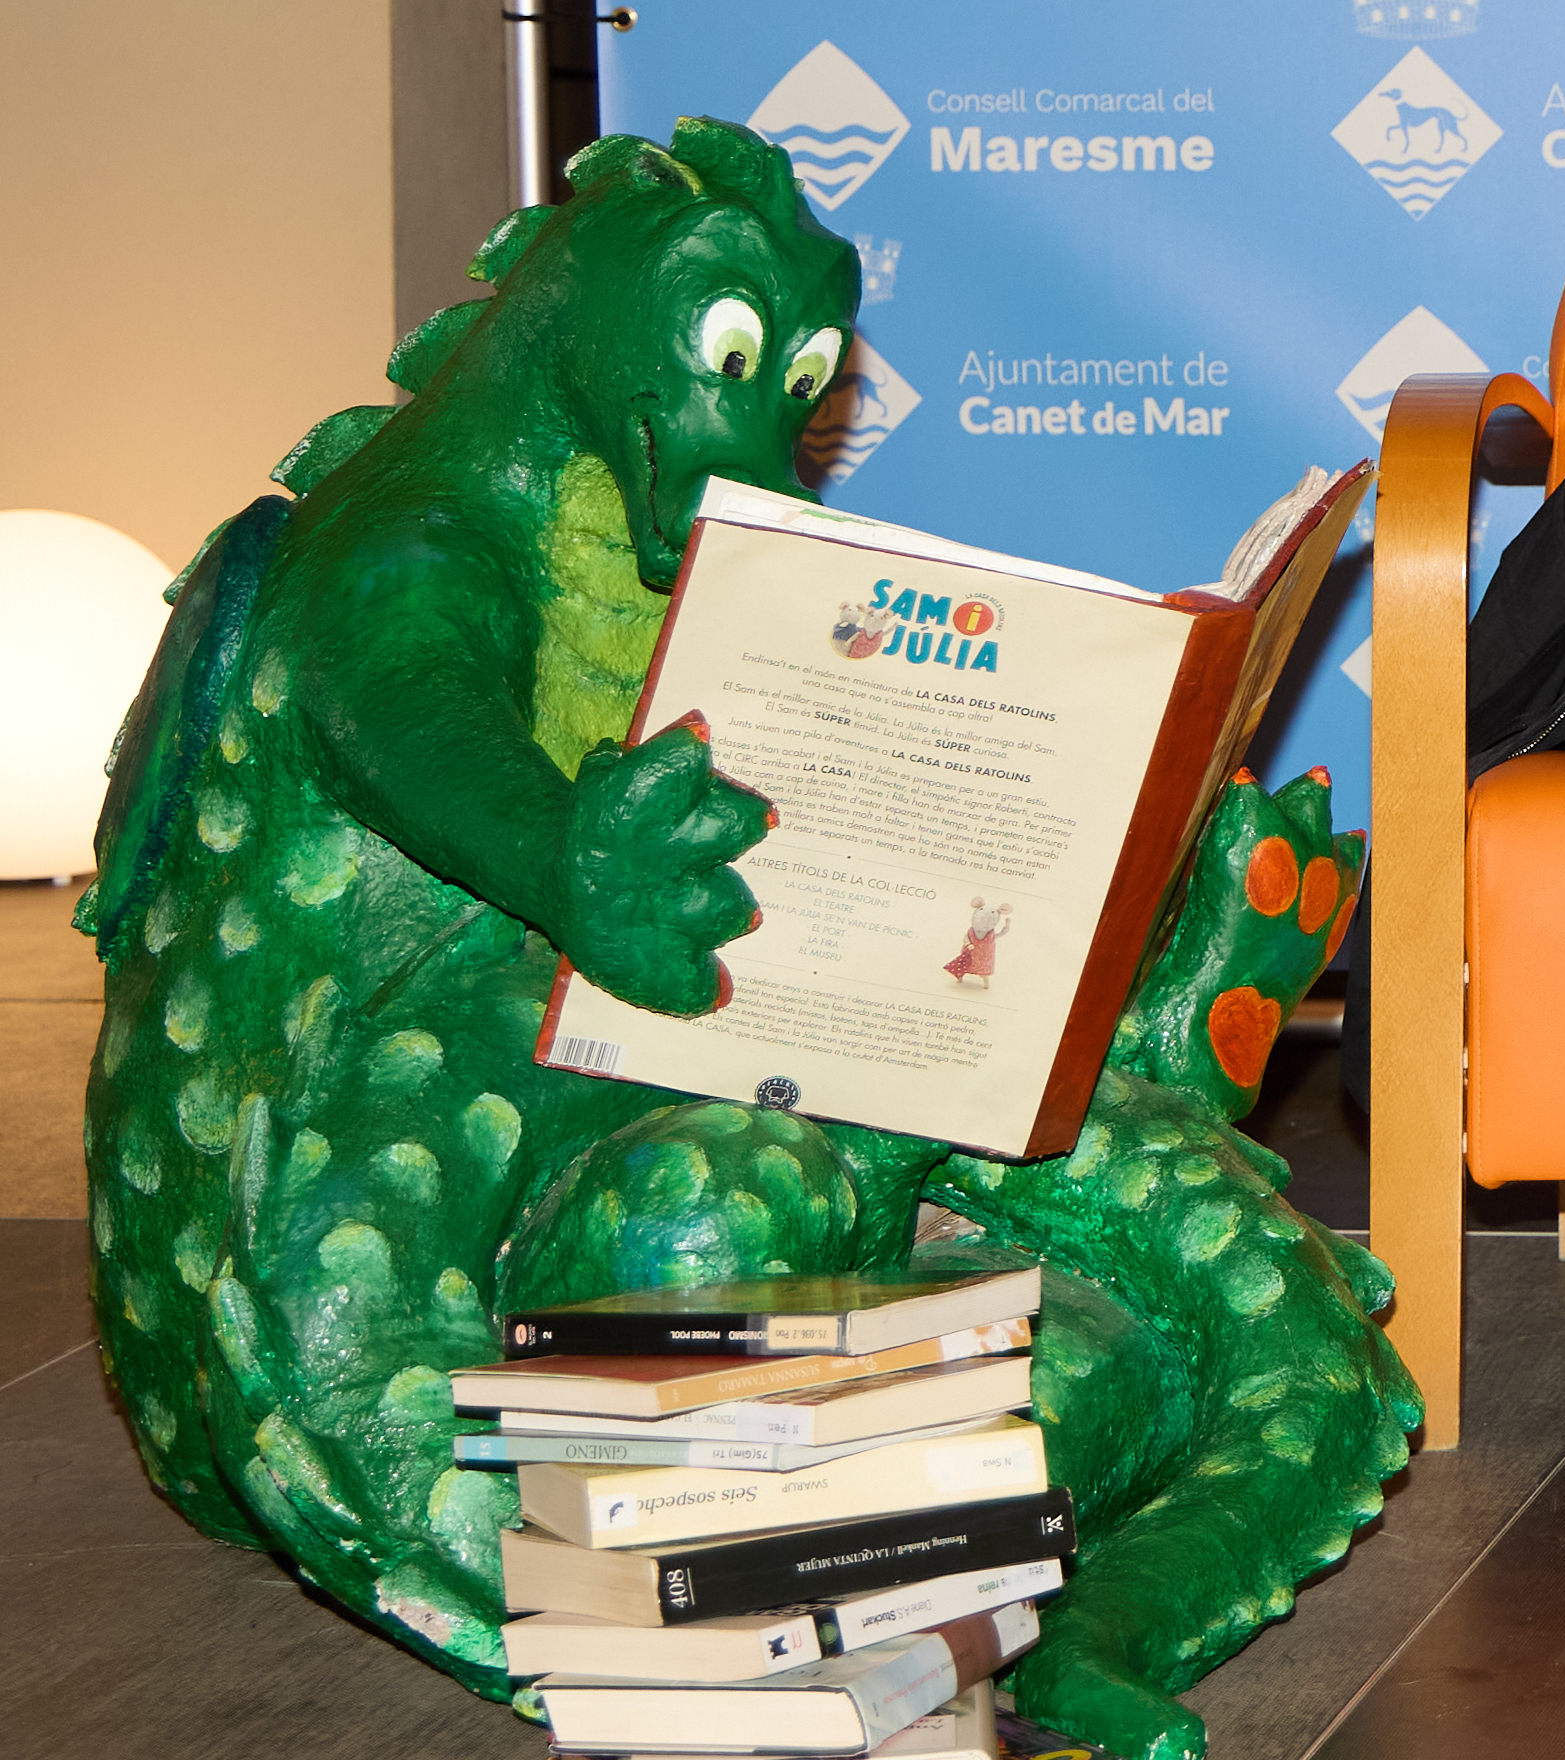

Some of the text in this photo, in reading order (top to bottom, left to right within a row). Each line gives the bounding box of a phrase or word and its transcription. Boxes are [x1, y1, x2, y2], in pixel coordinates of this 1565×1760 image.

[928, 87, 1214, 112] Consell Comarcal del
[930, 125, 1215, 173] Maresme
[958, 350, 1228, 393] Ajuntament de
[958, 395, 1230, 436] Canet de Mar
[868, 578, 952, 626] SAM
[881, 624, 999, 673] JÚLIA
[852, 677, 898, 695] miniatura
[901, 686, 913, 697] de
[916, 689, 930, 700] LA
[934, 692, 965, 706] CASA
[968, 698, 996, 710] DELS
[814, 711, 852, 727] SÚPER
[934, 738, 972, 753] SÚPER
[747, 856, 789, 871] ALTRES
[791, 862, 829, 879] TÍTOLS
[831, 870, 848, 883] DE
[850, 874, 864, 886] LA
[669, 1330, 721, 1340] PHOEBE POOL
[717, 1364, 821, 1393] SUSANNA TAMARO
[565, 1443, 628, 1461] GIMENO
[712, 1448, 769, 1461] 75(Gim) Tri
[720, 1485, 758, 1505] Seis
[781, 1479, 829, 1493] SWARUP
[897, 1541, 931, 1554] Mankell
[932, 1534, 968, 1550] Henning
[797, 1557, 831, 1572] MUJER
[832, 1549, 874, 1564] QUINTA
[665, 1569, 688, 1608] 408
